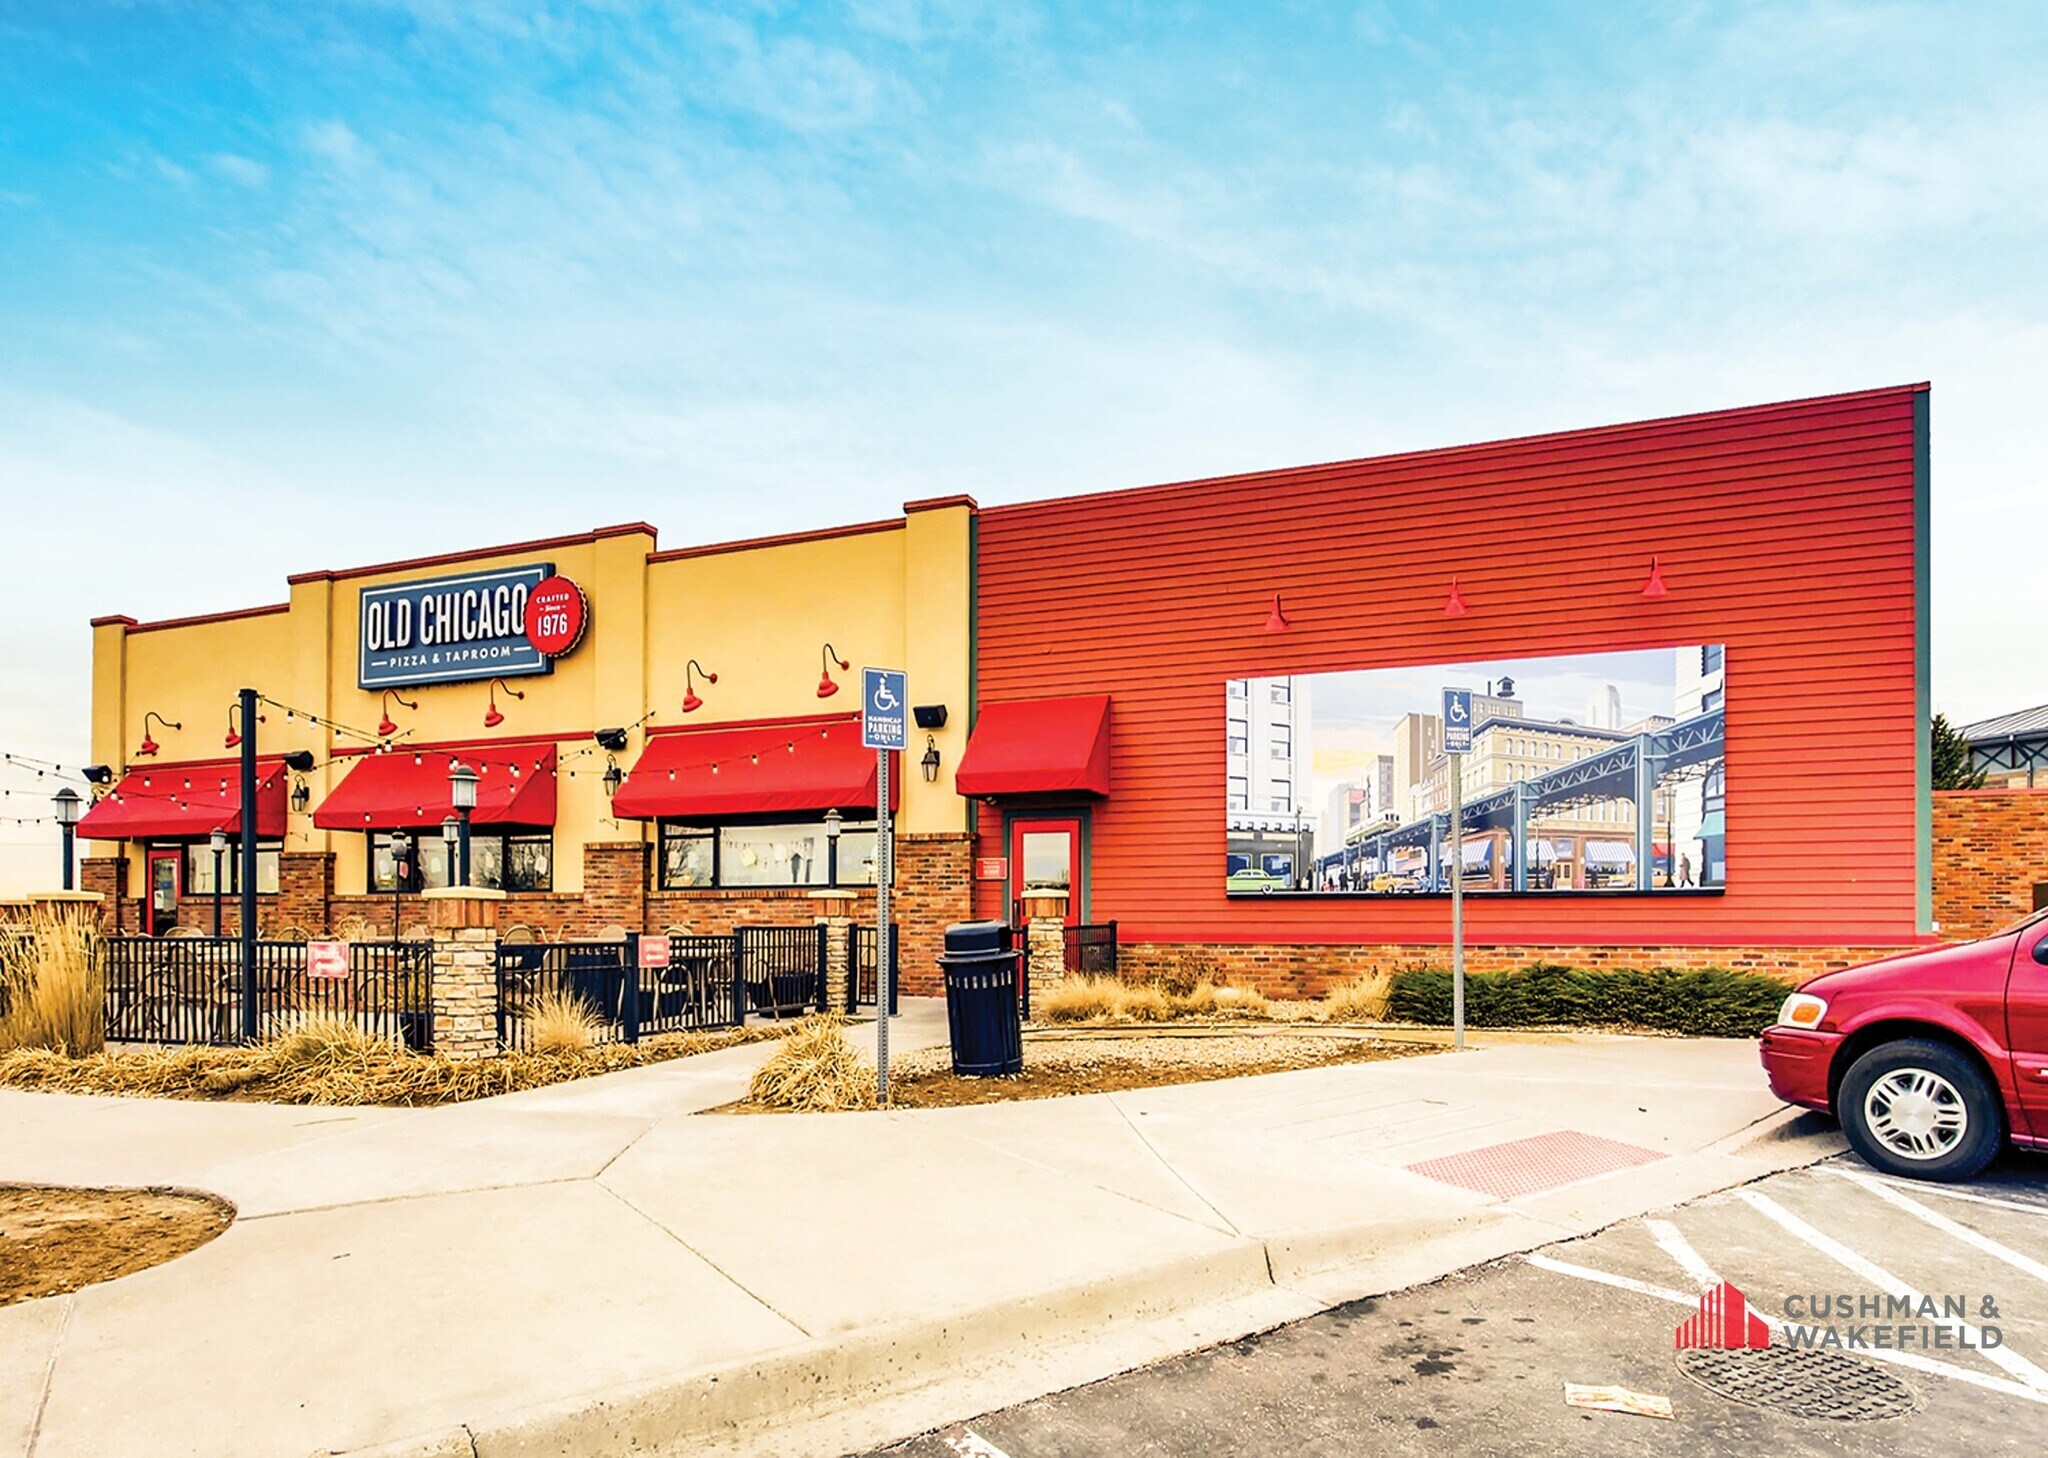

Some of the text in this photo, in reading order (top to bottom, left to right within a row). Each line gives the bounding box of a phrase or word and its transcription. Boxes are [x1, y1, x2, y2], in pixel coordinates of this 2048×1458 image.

[536, 593, 569, 604] CRAFTED
[368, 583, 527, 650] OLD CHICAGO
[537, 613, 568, 637] 1976
[390, 646, 511, 668] PIZZA & TAPROOM
[868, 715, 902, 723] HANDICAP
[868, 722, 902, 735] PARKING
[874, 733, 896, 741] ONLY
